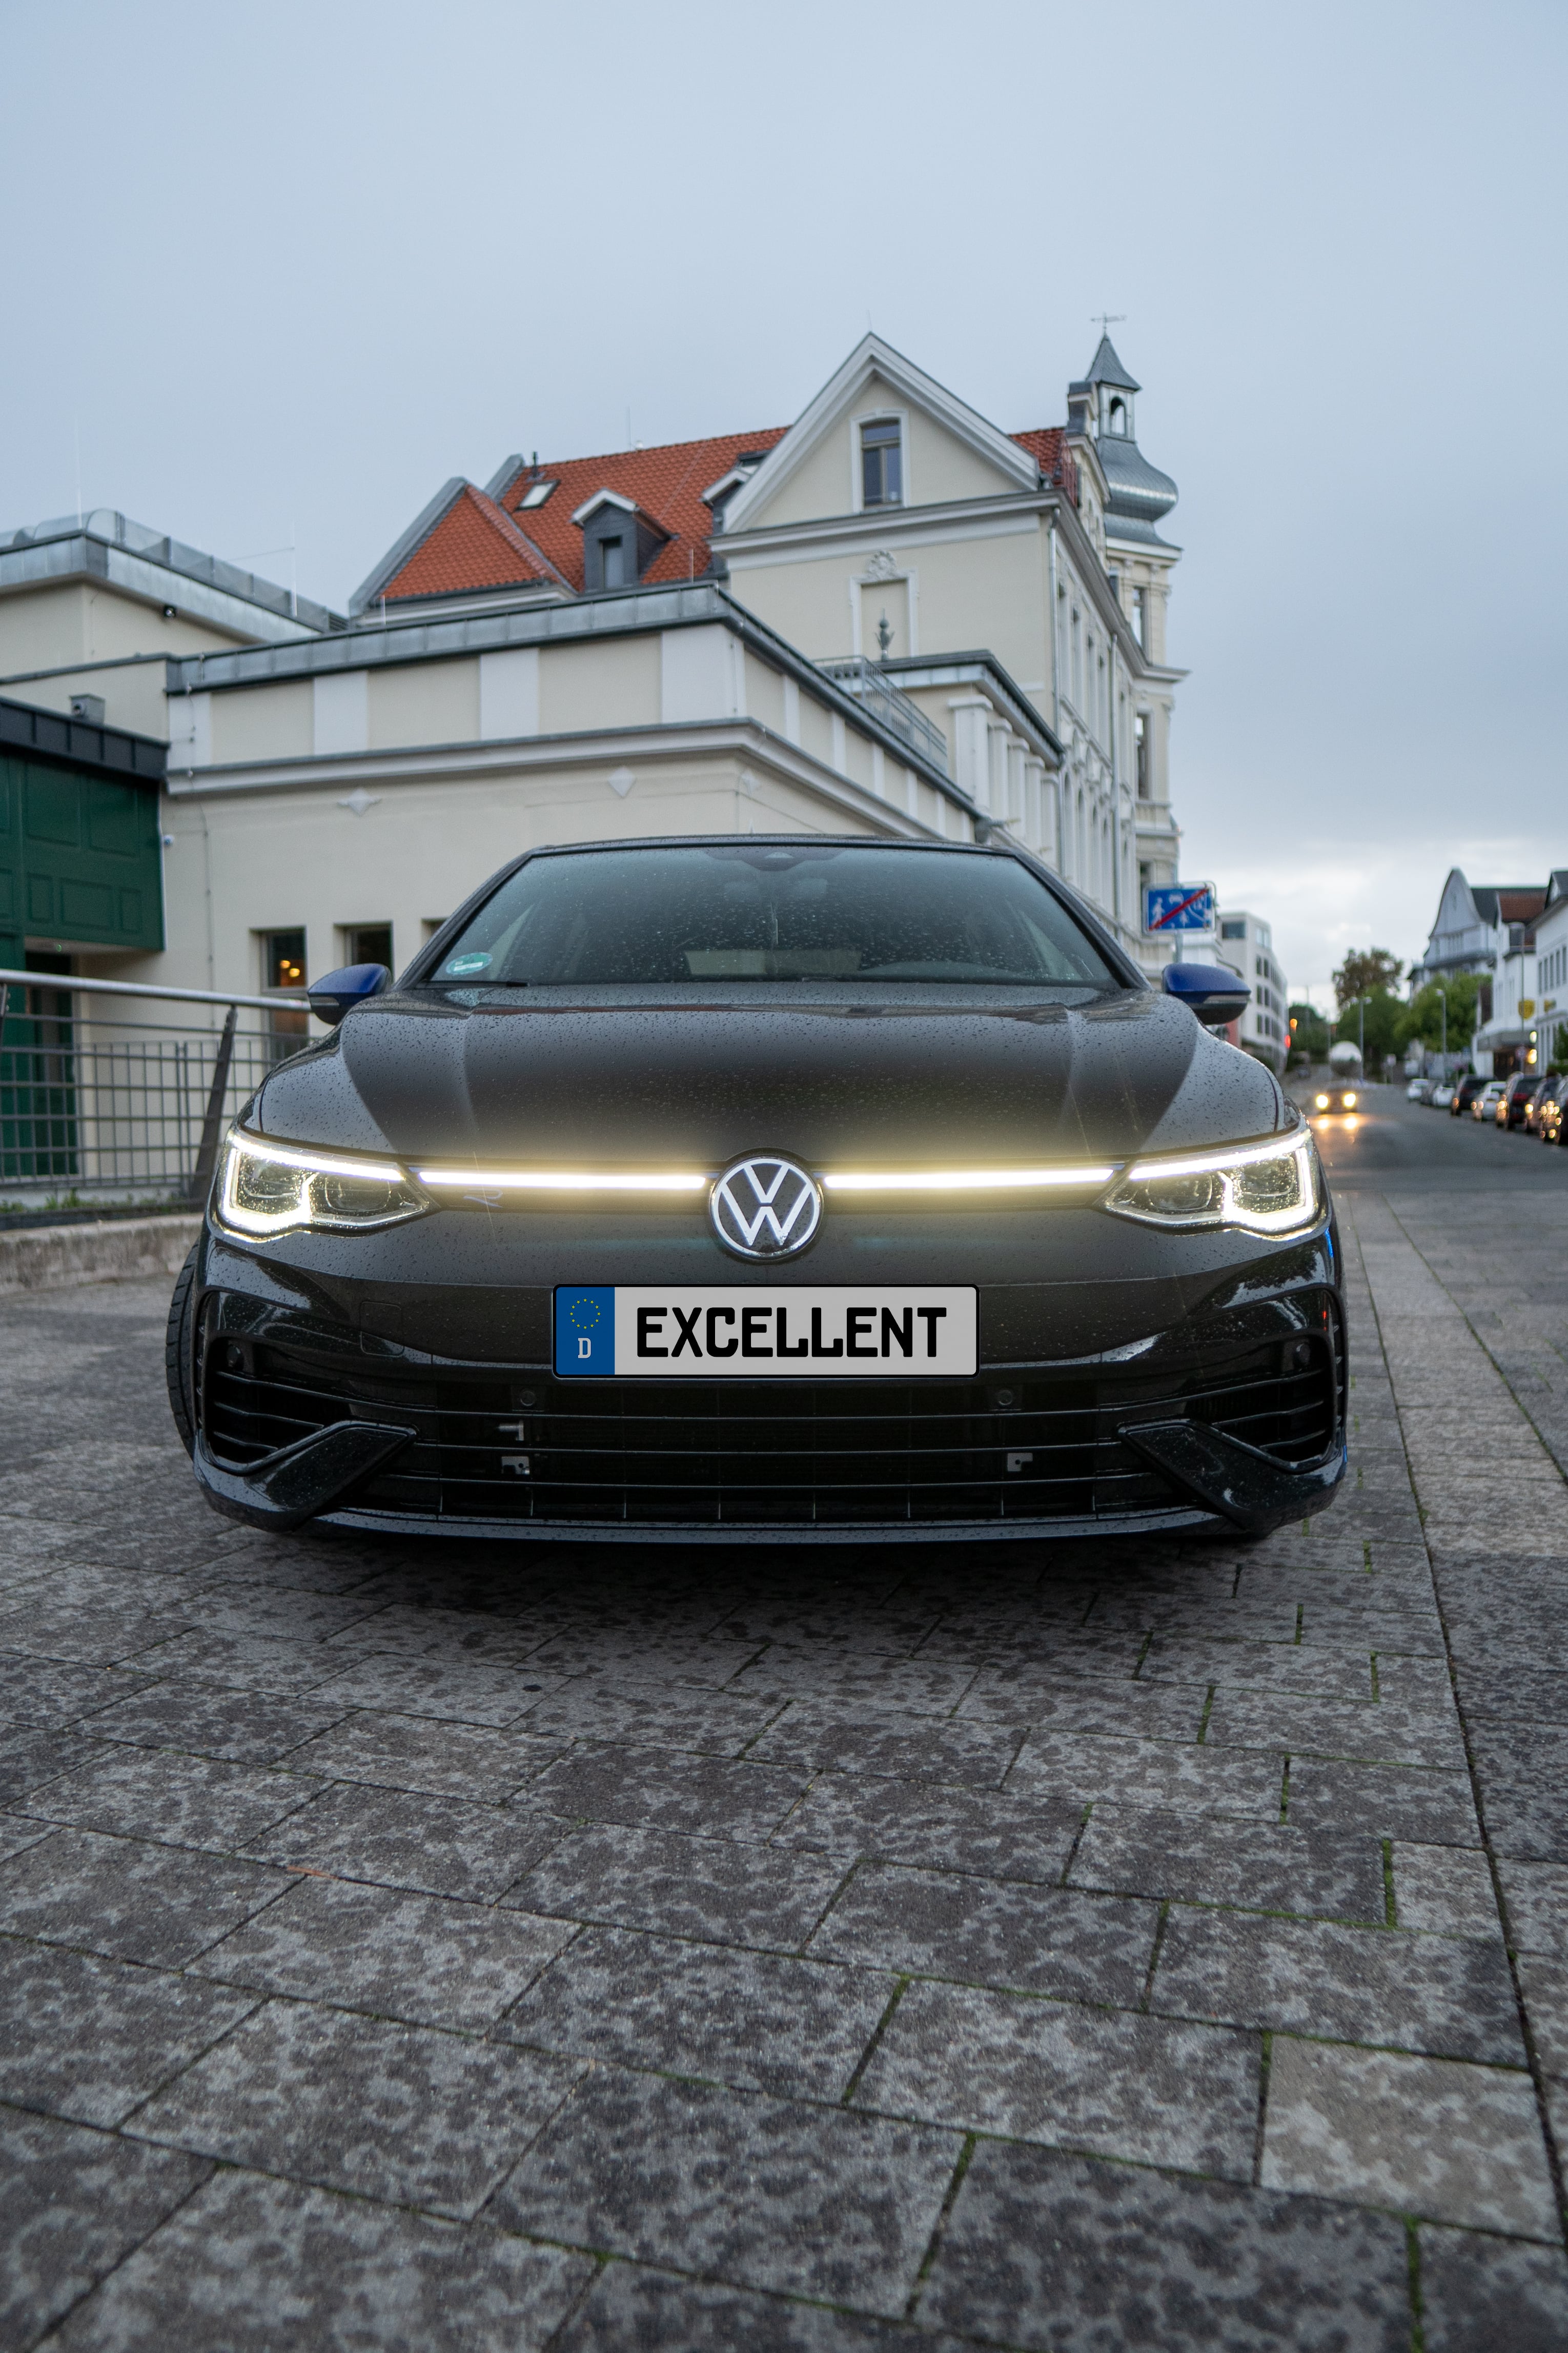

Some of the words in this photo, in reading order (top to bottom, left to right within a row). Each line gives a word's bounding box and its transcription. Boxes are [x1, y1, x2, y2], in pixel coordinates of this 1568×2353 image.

[718, 1159, 815, 1248] VW
[578, 1338, 592, 1358] D
[637, 1307, 947, 1357] EXCELLENT
